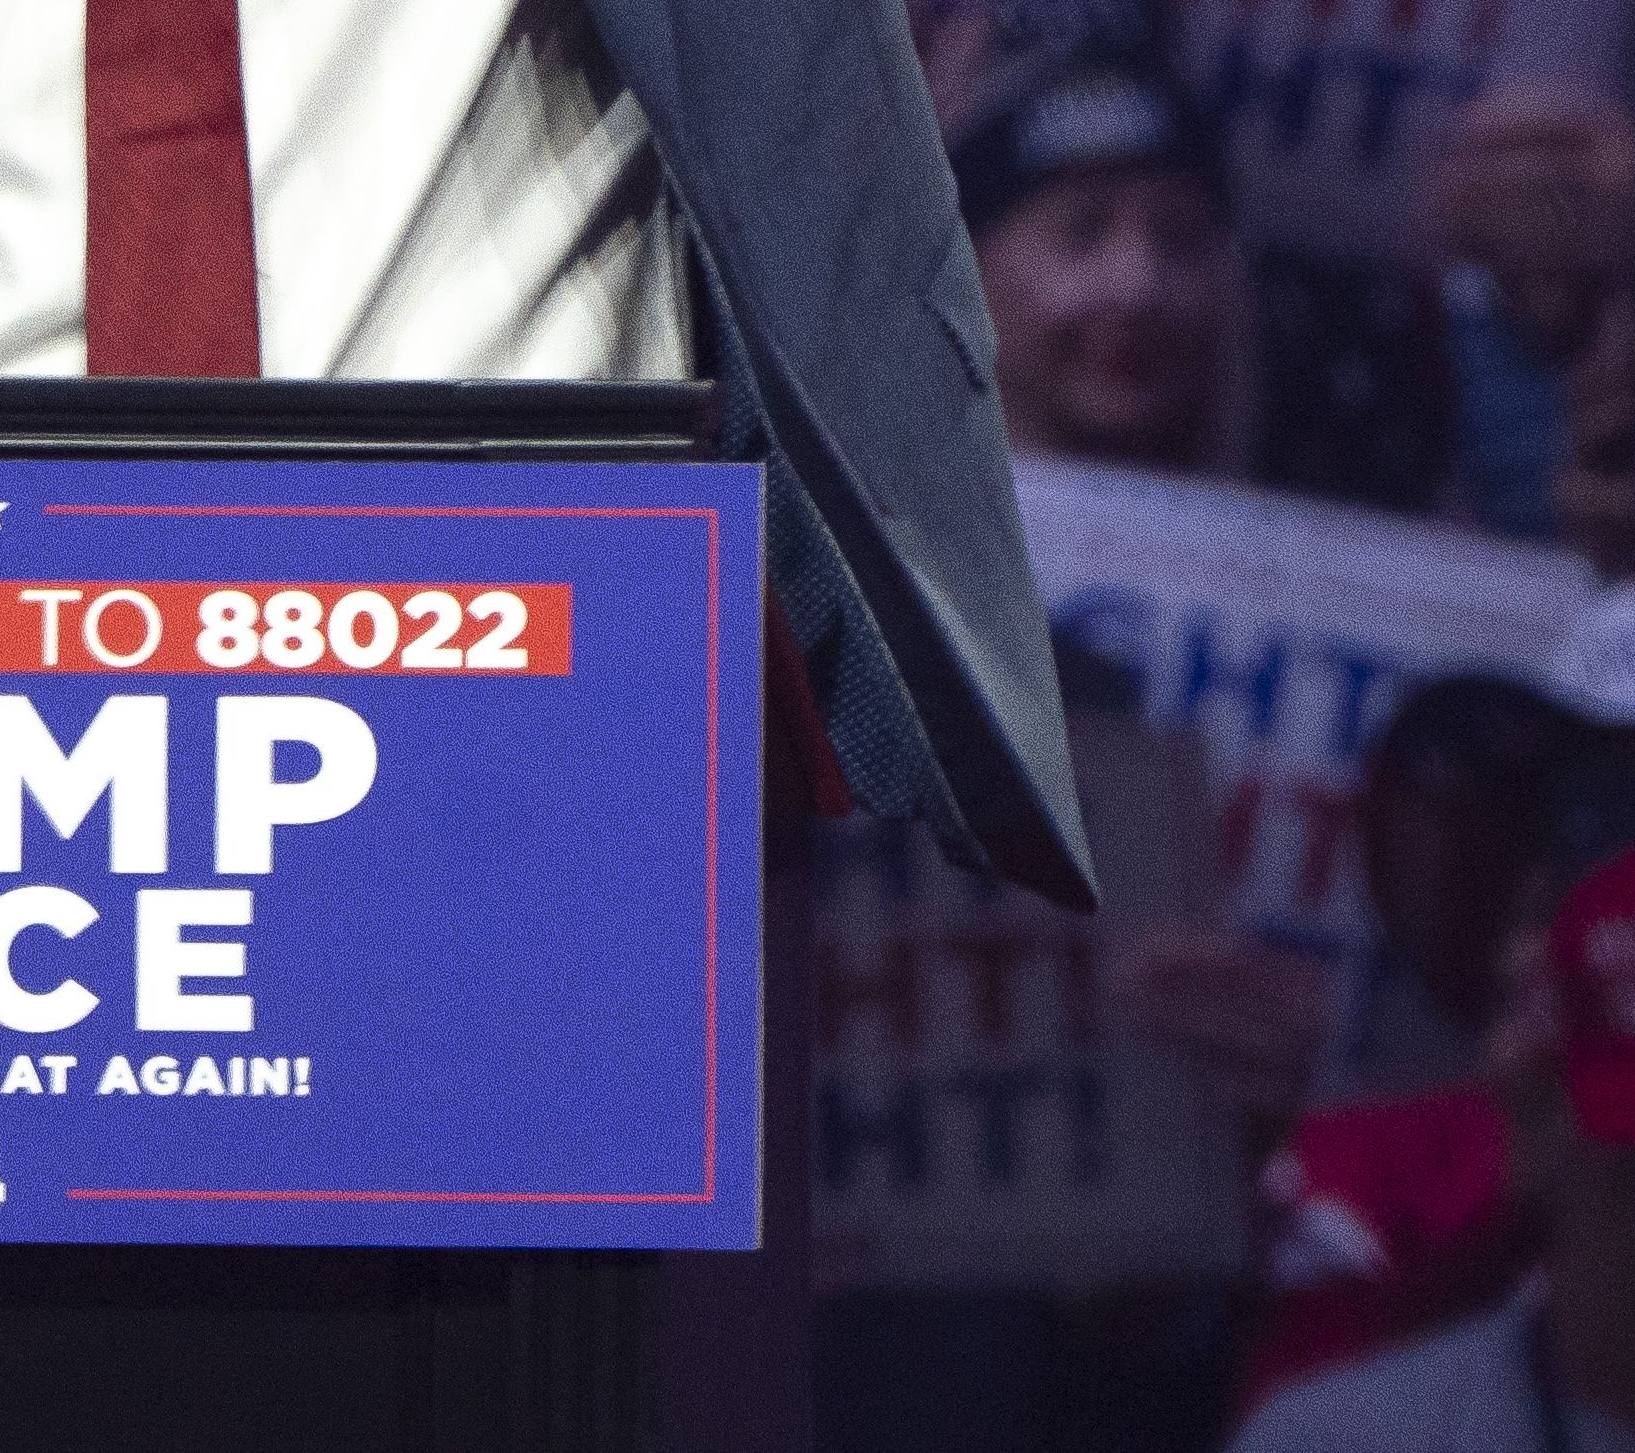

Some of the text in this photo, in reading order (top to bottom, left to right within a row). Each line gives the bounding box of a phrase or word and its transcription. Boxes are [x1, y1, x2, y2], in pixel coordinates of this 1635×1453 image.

[19, 589, 163, 668] TO
[195, 589, 528, 670] 88022
[97, 1053, 311, 1097] AGAIN!
